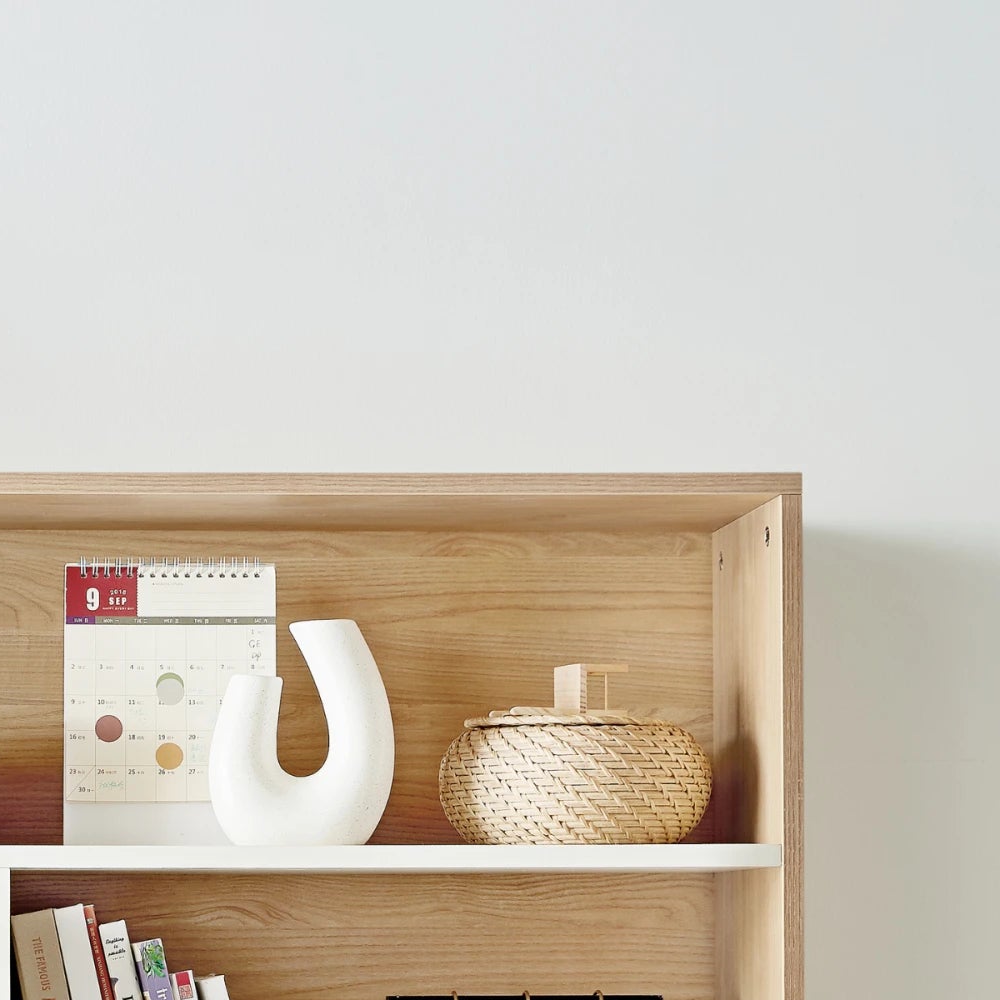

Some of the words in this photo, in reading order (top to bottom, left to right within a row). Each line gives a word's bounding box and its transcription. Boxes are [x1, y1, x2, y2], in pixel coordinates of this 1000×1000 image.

[86, 588, 100, 610] 9
[109, 597, 127, 605] SEP
[32, 937, 44, 955] THE
[35, 956, 51, 991] FAMOUS
